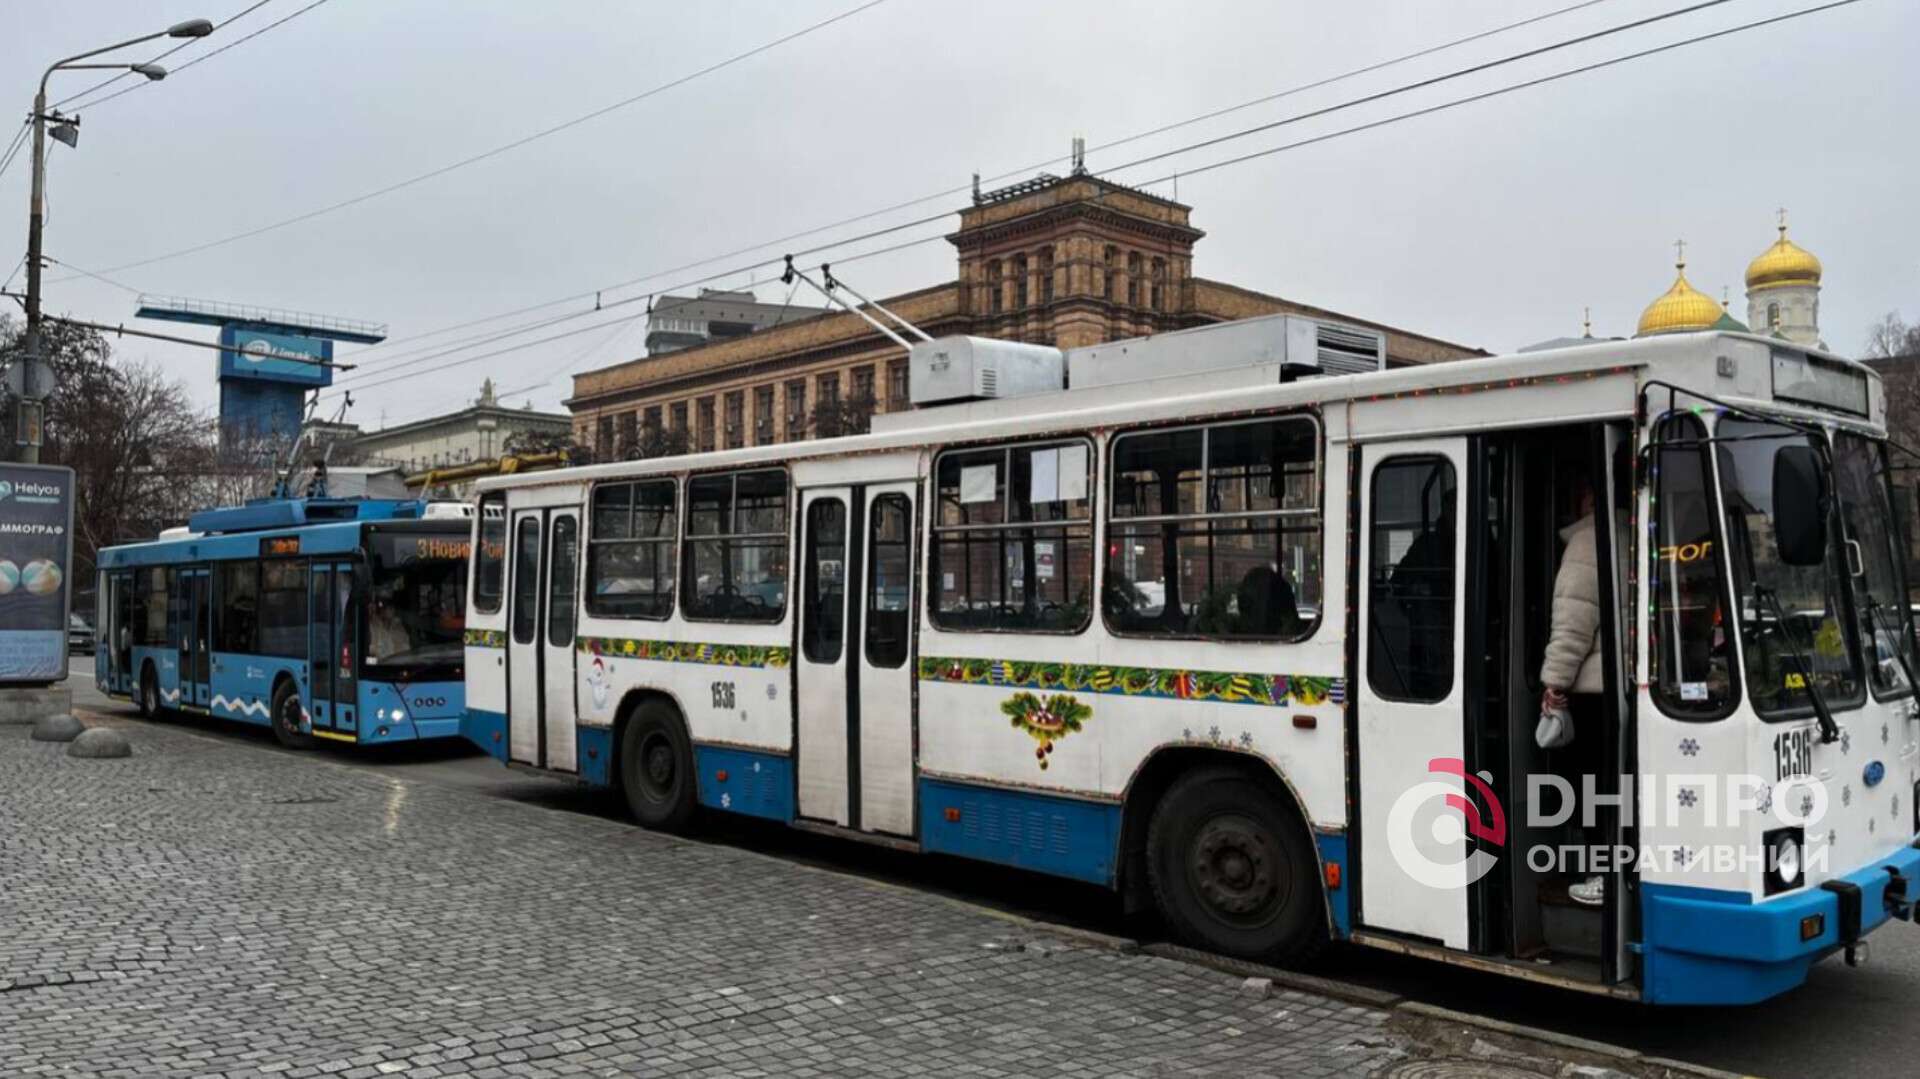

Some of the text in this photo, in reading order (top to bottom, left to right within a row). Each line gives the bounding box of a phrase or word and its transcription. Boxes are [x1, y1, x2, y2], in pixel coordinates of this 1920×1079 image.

[15, 481, 60, 496] Helyos
[0, 523, 64, 535] ММОГРАФ
[711, 681, 735, 709] 1536
[1773, 728, 1812, 782] 1536
